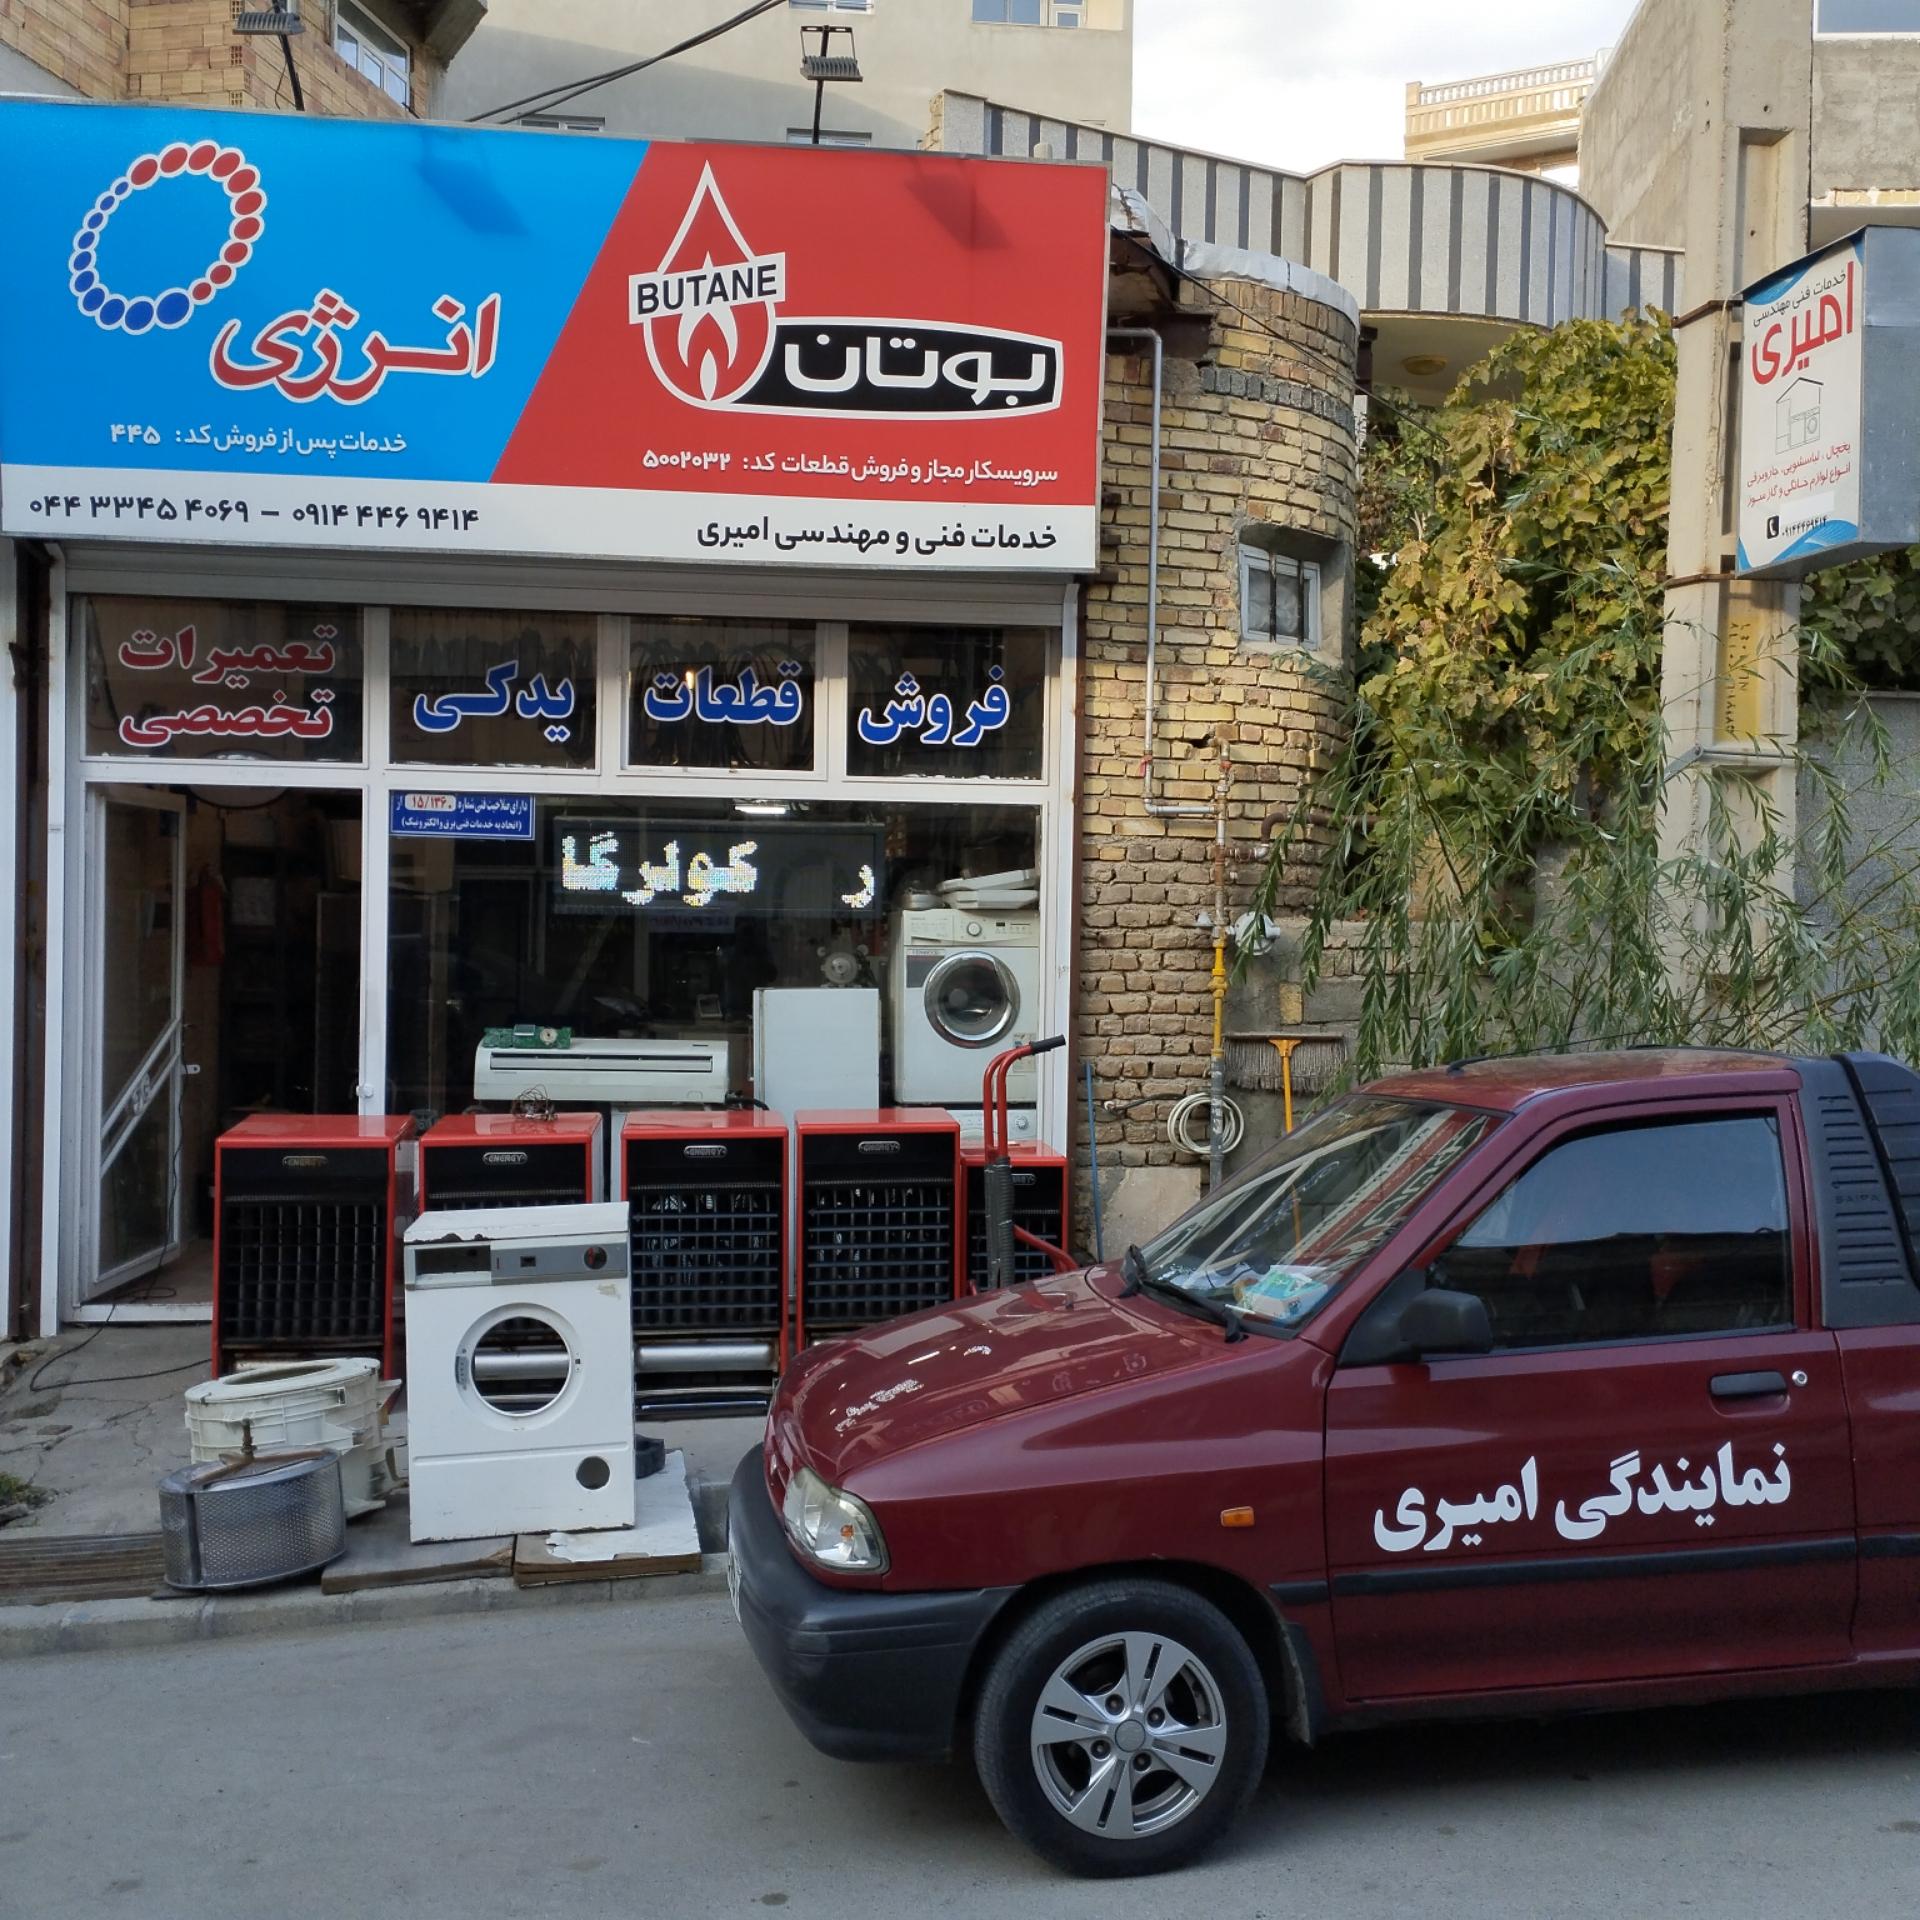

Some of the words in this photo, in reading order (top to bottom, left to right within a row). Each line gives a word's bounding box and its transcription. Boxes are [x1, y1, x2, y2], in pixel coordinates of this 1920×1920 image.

[637, 263, 778, 316] BUTANE
[1813, 269, 1846, 296] خدمات
[1792, 286, 1811, 309] فنی
[1752, 261, 1855, 385] امیری
[1753, 300, 1791, 328] مهندسی
[209, 288, 501, 405] انرژی
[783, 333, 1046, 406] بوتان
[110, 423, 161, 445] ۴۴۵
[214, 425, 278, 453] فروش
[279, 428, 294, 453] از
[296, 434, 337, 459] پس
[339, 431, 408, 453] خدمات
[642, 449, 731, 471] ۵۰۰۲۰۳۲
[780, 453, 850, 476] قطعات
[850, 454, 909, 483] فروش
[924, 459, 965, 485] مجاز
[965, 462, 1059, 486] سرویسکار
[910, 466, 922, 484] و
[29, 495, 81, 519] ۰۴۴
[90, 496, 178, 521] ۳۳۴۵
[184, 498, 249, 523] ۴۰۶۹
[292, 502, 349, 526] ۰۹۱۴
[357, 504, 409, 529] ۴۴۶
[416, 506, 480, 531] ۹۴۱۴
[696, 515, 769, 549] امیری
[774, 519, 890, 554] مهندسی
[895, 530, 909, 555] و
[914, 520, 965, 553] فنی
[970, 522, 1058, 550] خدمات
[118, 624, 337, 689] تعمیرات
[413, 660, 576, 743] یدکی
[643, 659, 804, 727] قطعات
[857, 664, 1011, 747] فروش
[119, 688, 336, 747] تخصصی
[1373, 1455, 1539, 1552] امیری
[1555, 1441, 1792, 1541] نمایندگی
